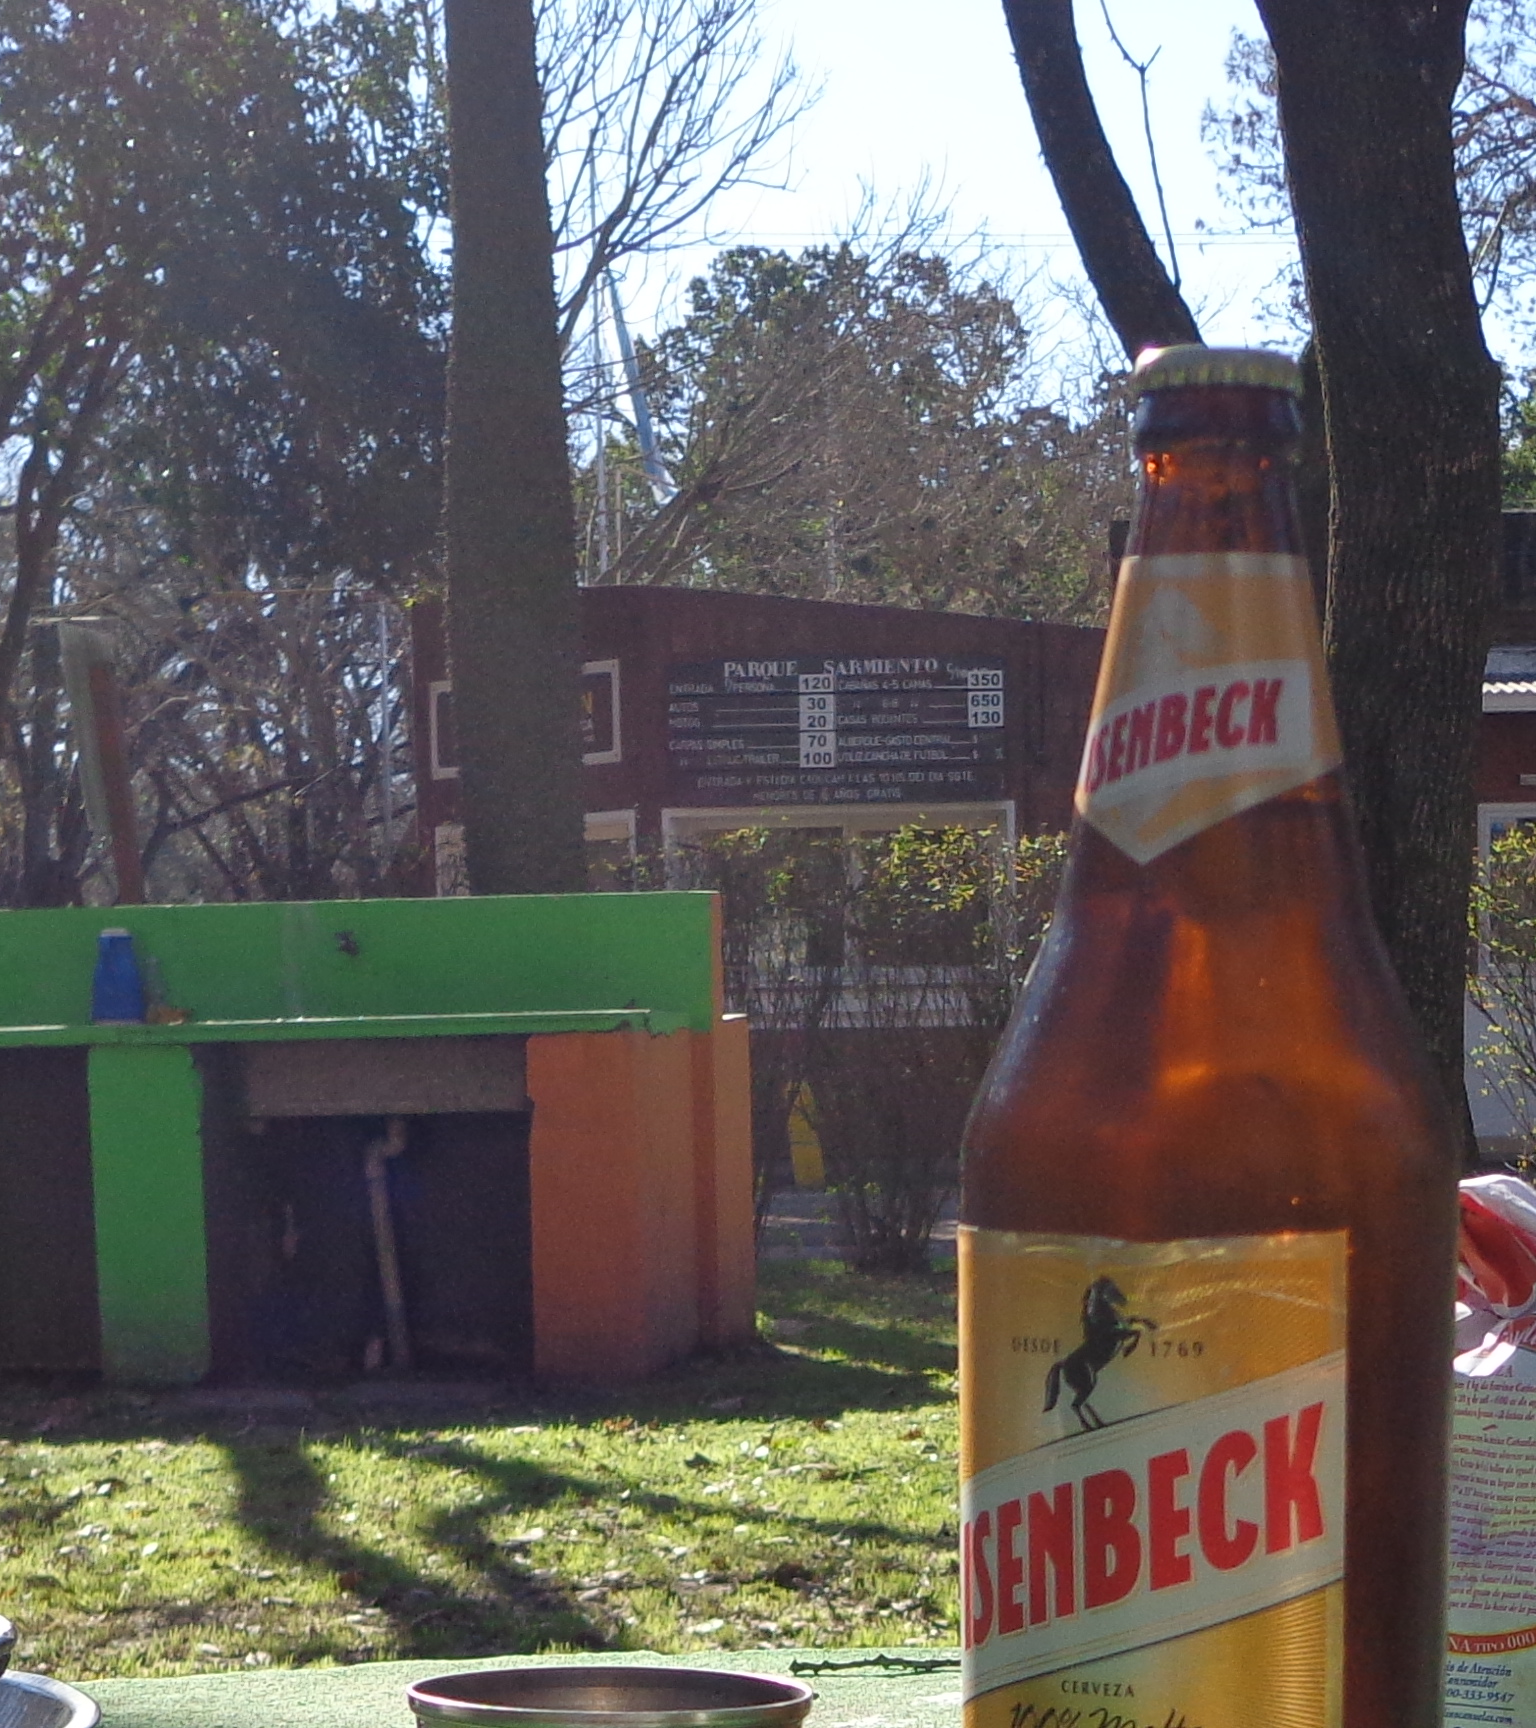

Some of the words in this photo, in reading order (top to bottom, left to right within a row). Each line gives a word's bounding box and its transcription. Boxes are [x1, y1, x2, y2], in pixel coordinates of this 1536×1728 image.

[724, 661, 798, 677] PARQUE
[823, 658, 938, 676] SARMIENTO
[802, 677, 831, 690] 120
[970, 674, 1000, 686] 350
[807, 698, 826, 710] 30
[971, 695, 1000, 707] 650
[807, 716, 827, 728] 20
[972, 712, 1000, 724] 130
[808, 735, 827, 747] 70
[803, 752, 832, 765] 100
[1150, 1340, 1205, 1358] 1769
[1060, 1680, 1135, 1698] CERVEZA
[1446, 1689, 1515, 1704] 00-333-9547
